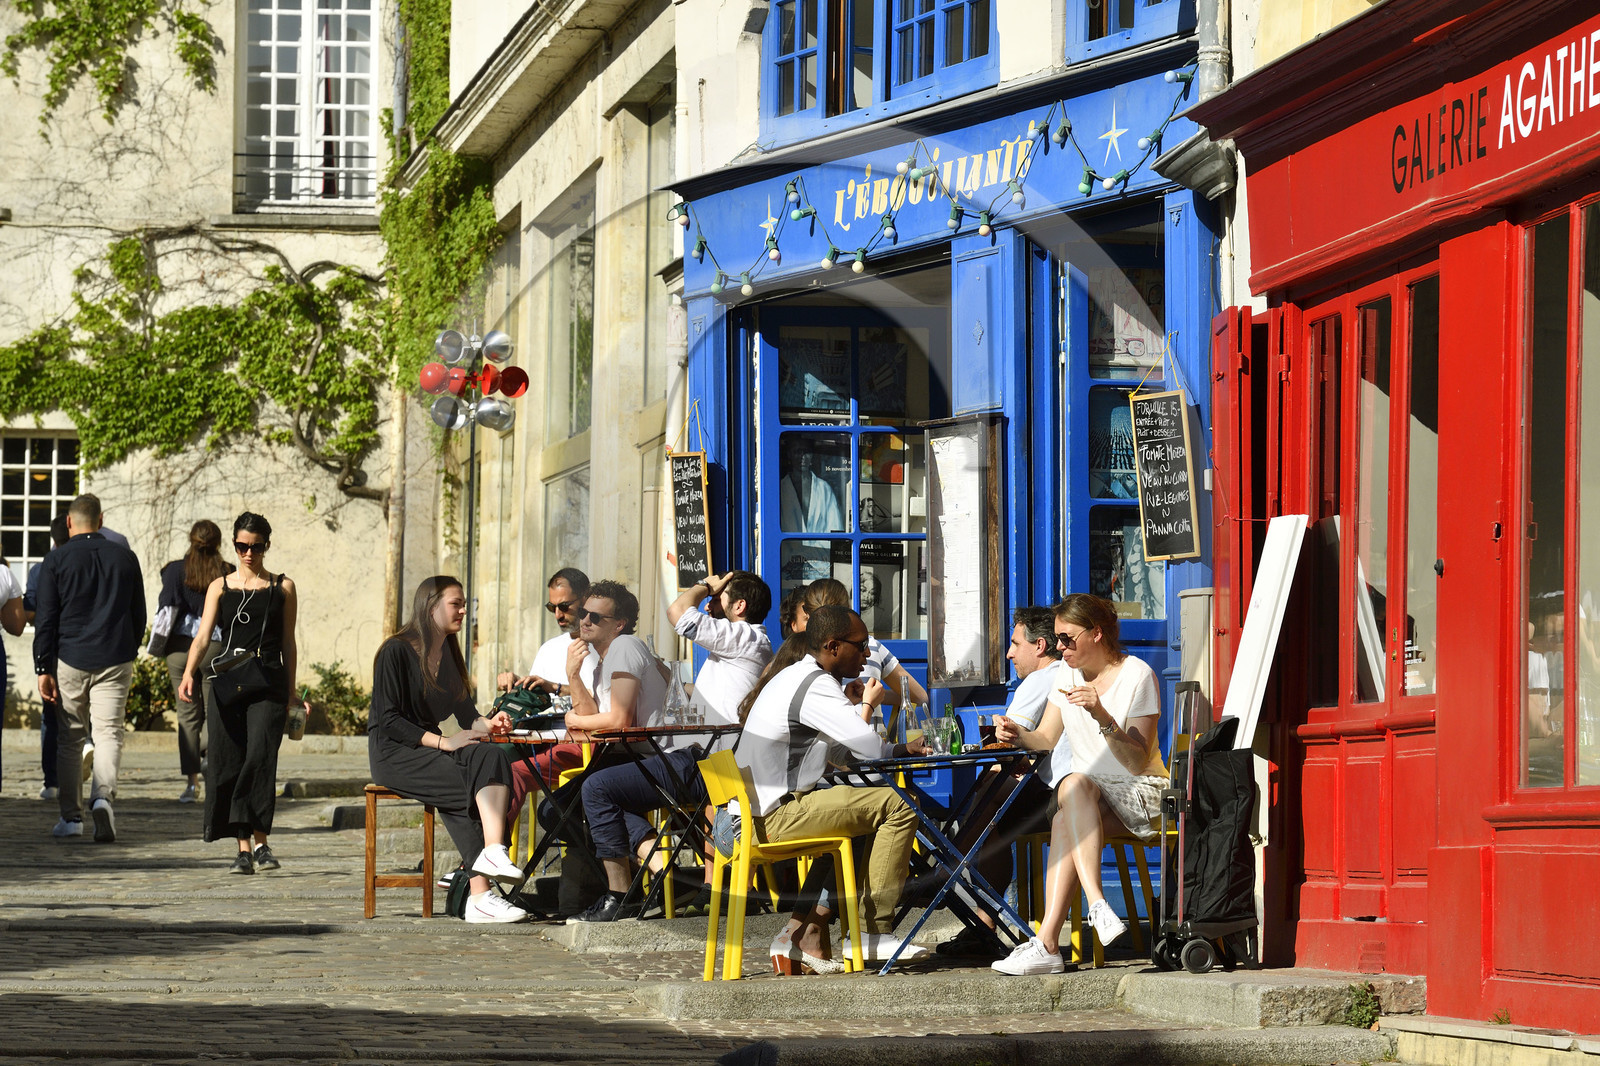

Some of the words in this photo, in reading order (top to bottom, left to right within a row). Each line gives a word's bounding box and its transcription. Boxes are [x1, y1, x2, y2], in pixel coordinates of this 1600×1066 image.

[1392, 86, 1487, 193] GALERIE
[1498, 28, 1600, 149] AGATHE
[1139, 444, 1166, 463] TOMATE
